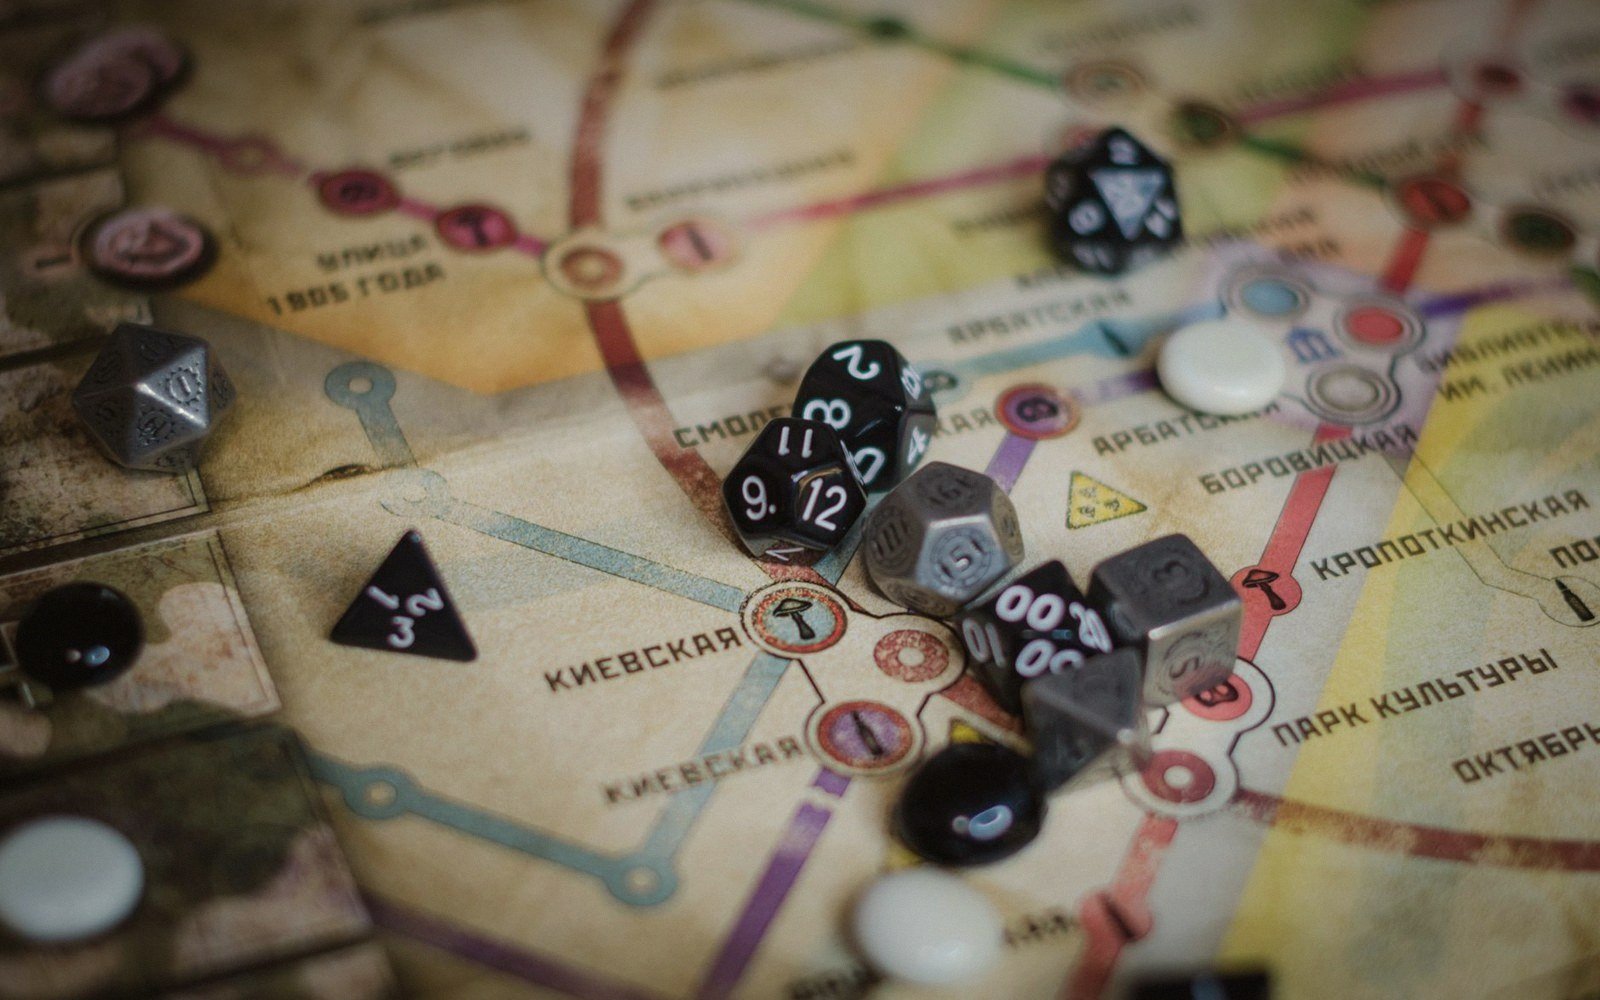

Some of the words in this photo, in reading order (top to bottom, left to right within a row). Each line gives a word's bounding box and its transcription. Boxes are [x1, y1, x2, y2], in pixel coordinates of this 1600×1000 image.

[832, 345, 881, 381] 2
[1199, 422, 1418, 495] БОРОВИЦКАЯ
[801, 476, 848, 532] 12
[1310, 489, 1591, 581] КРОПОТКИНСКАЯ
[1549, 533, 1600, 569] ПО
[407, 587, 445, 617] 2
[995, 584, 1067, 632] 00
[388, 615, 416, 649] 3
[544, 626, 743, 693] КИЕВСКАЯ
[1272, 702, 1370, 748] ПАРК
[1369, 647, 1560, 720] КУЛЬТУРЫ
[603, 734, 805, 804] КИЕВСКАЯ
